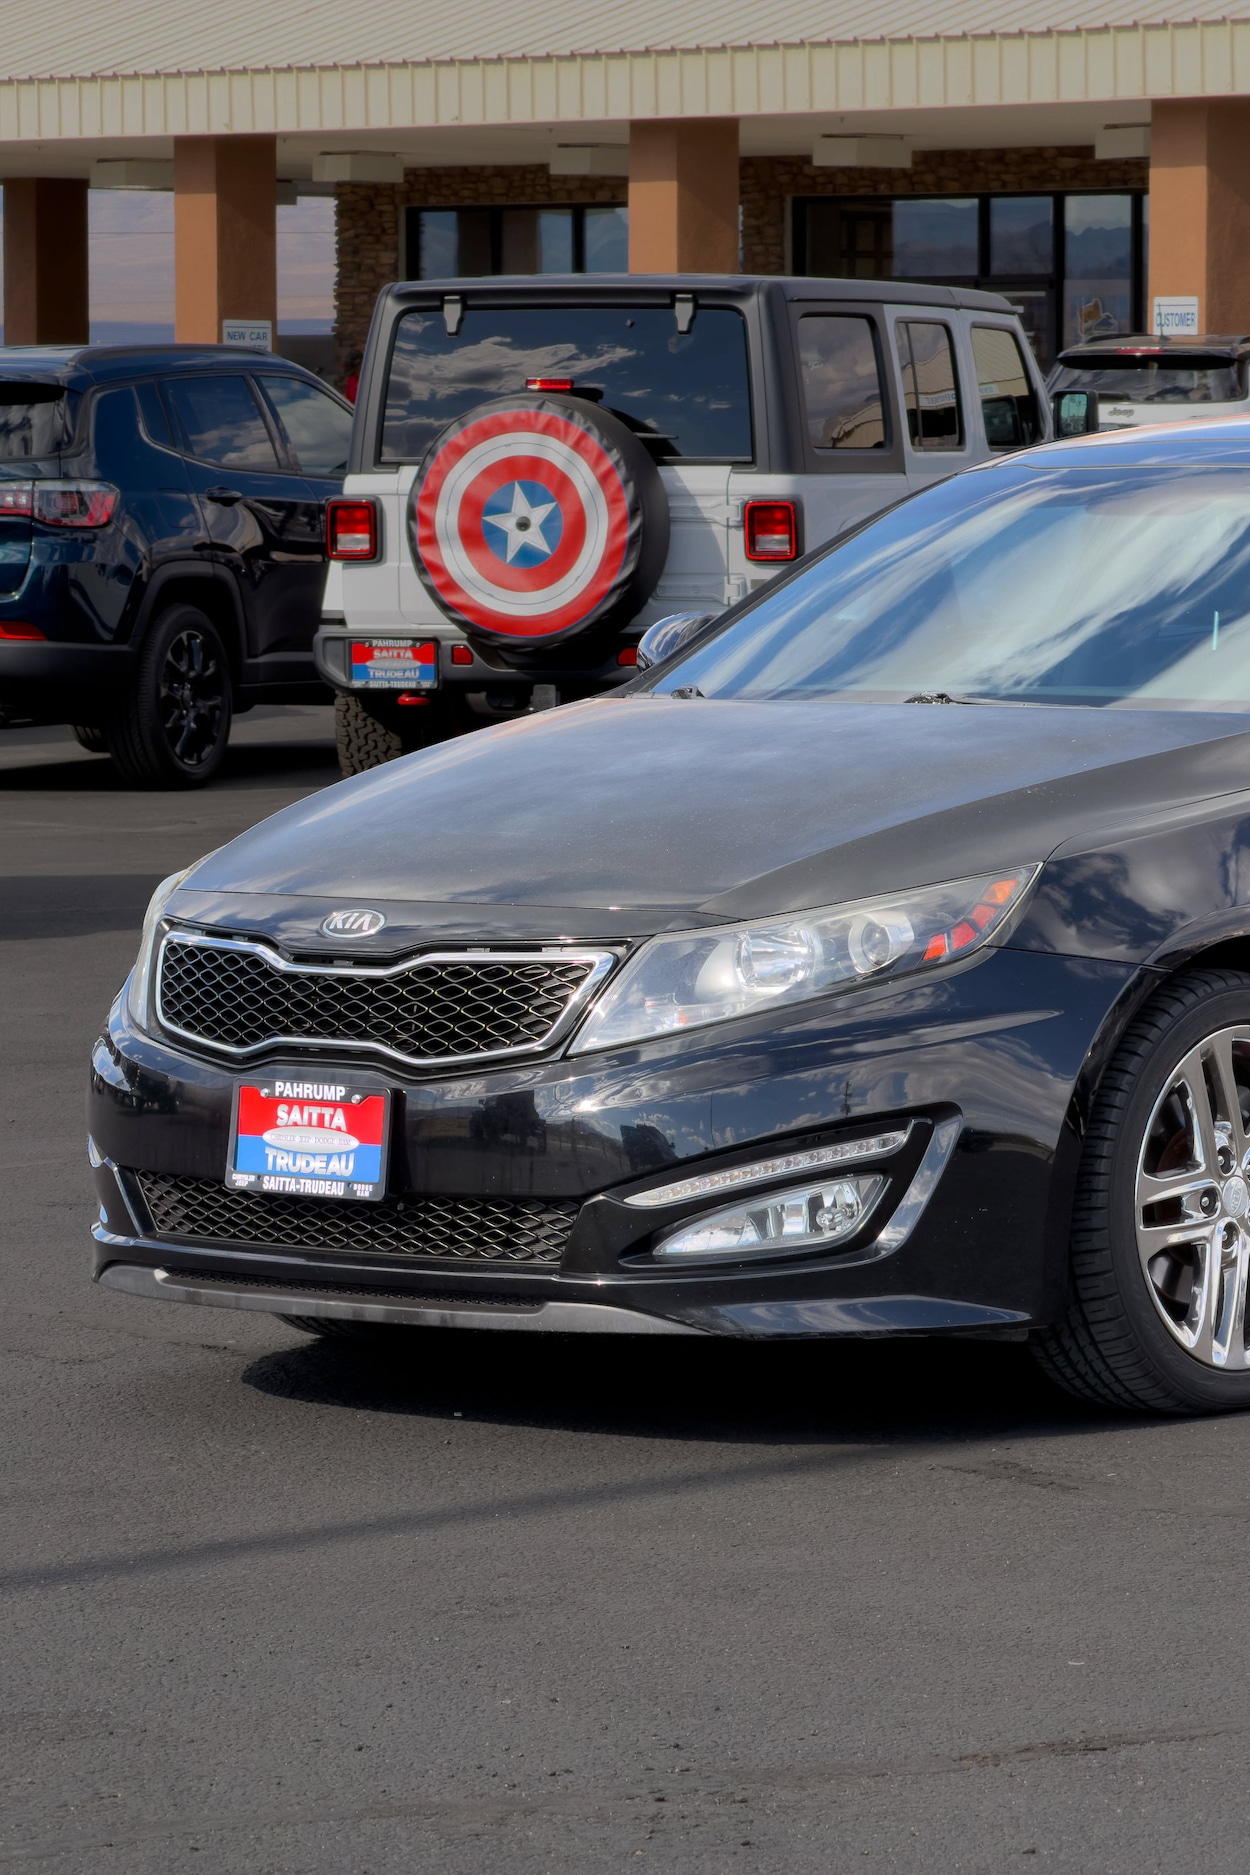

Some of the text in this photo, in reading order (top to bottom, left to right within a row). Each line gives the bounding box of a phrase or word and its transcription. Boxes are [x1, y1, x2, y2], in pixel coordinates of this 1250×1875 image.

[1156, 312, 1196, 327] CUSTOMER
[227, 331, 268, 341] NEW CAR
[1108, 407, 1135, 418] Jeep
[372, 639, 413, 647] PAHRUMP
[373, 649, 413, 659] SAITTA
[368, 668, 420, 679] TRUDEAU
[328, 912, 373, 931] KIA
[274, 1081, 346, 1101] PAHRUMP
[276, 1104, 347, 1132] SAITTA
[270, 1134, 297, 1143] CHRYSLER
[299, 1135, 312, 1144] JEEP
[314, 1136, 336, 1145] DODGE
[265, 1147, 355, 1177] TRUDEAU
[262, 1175, 345, 1196] SAITTA-TRUDEAU
